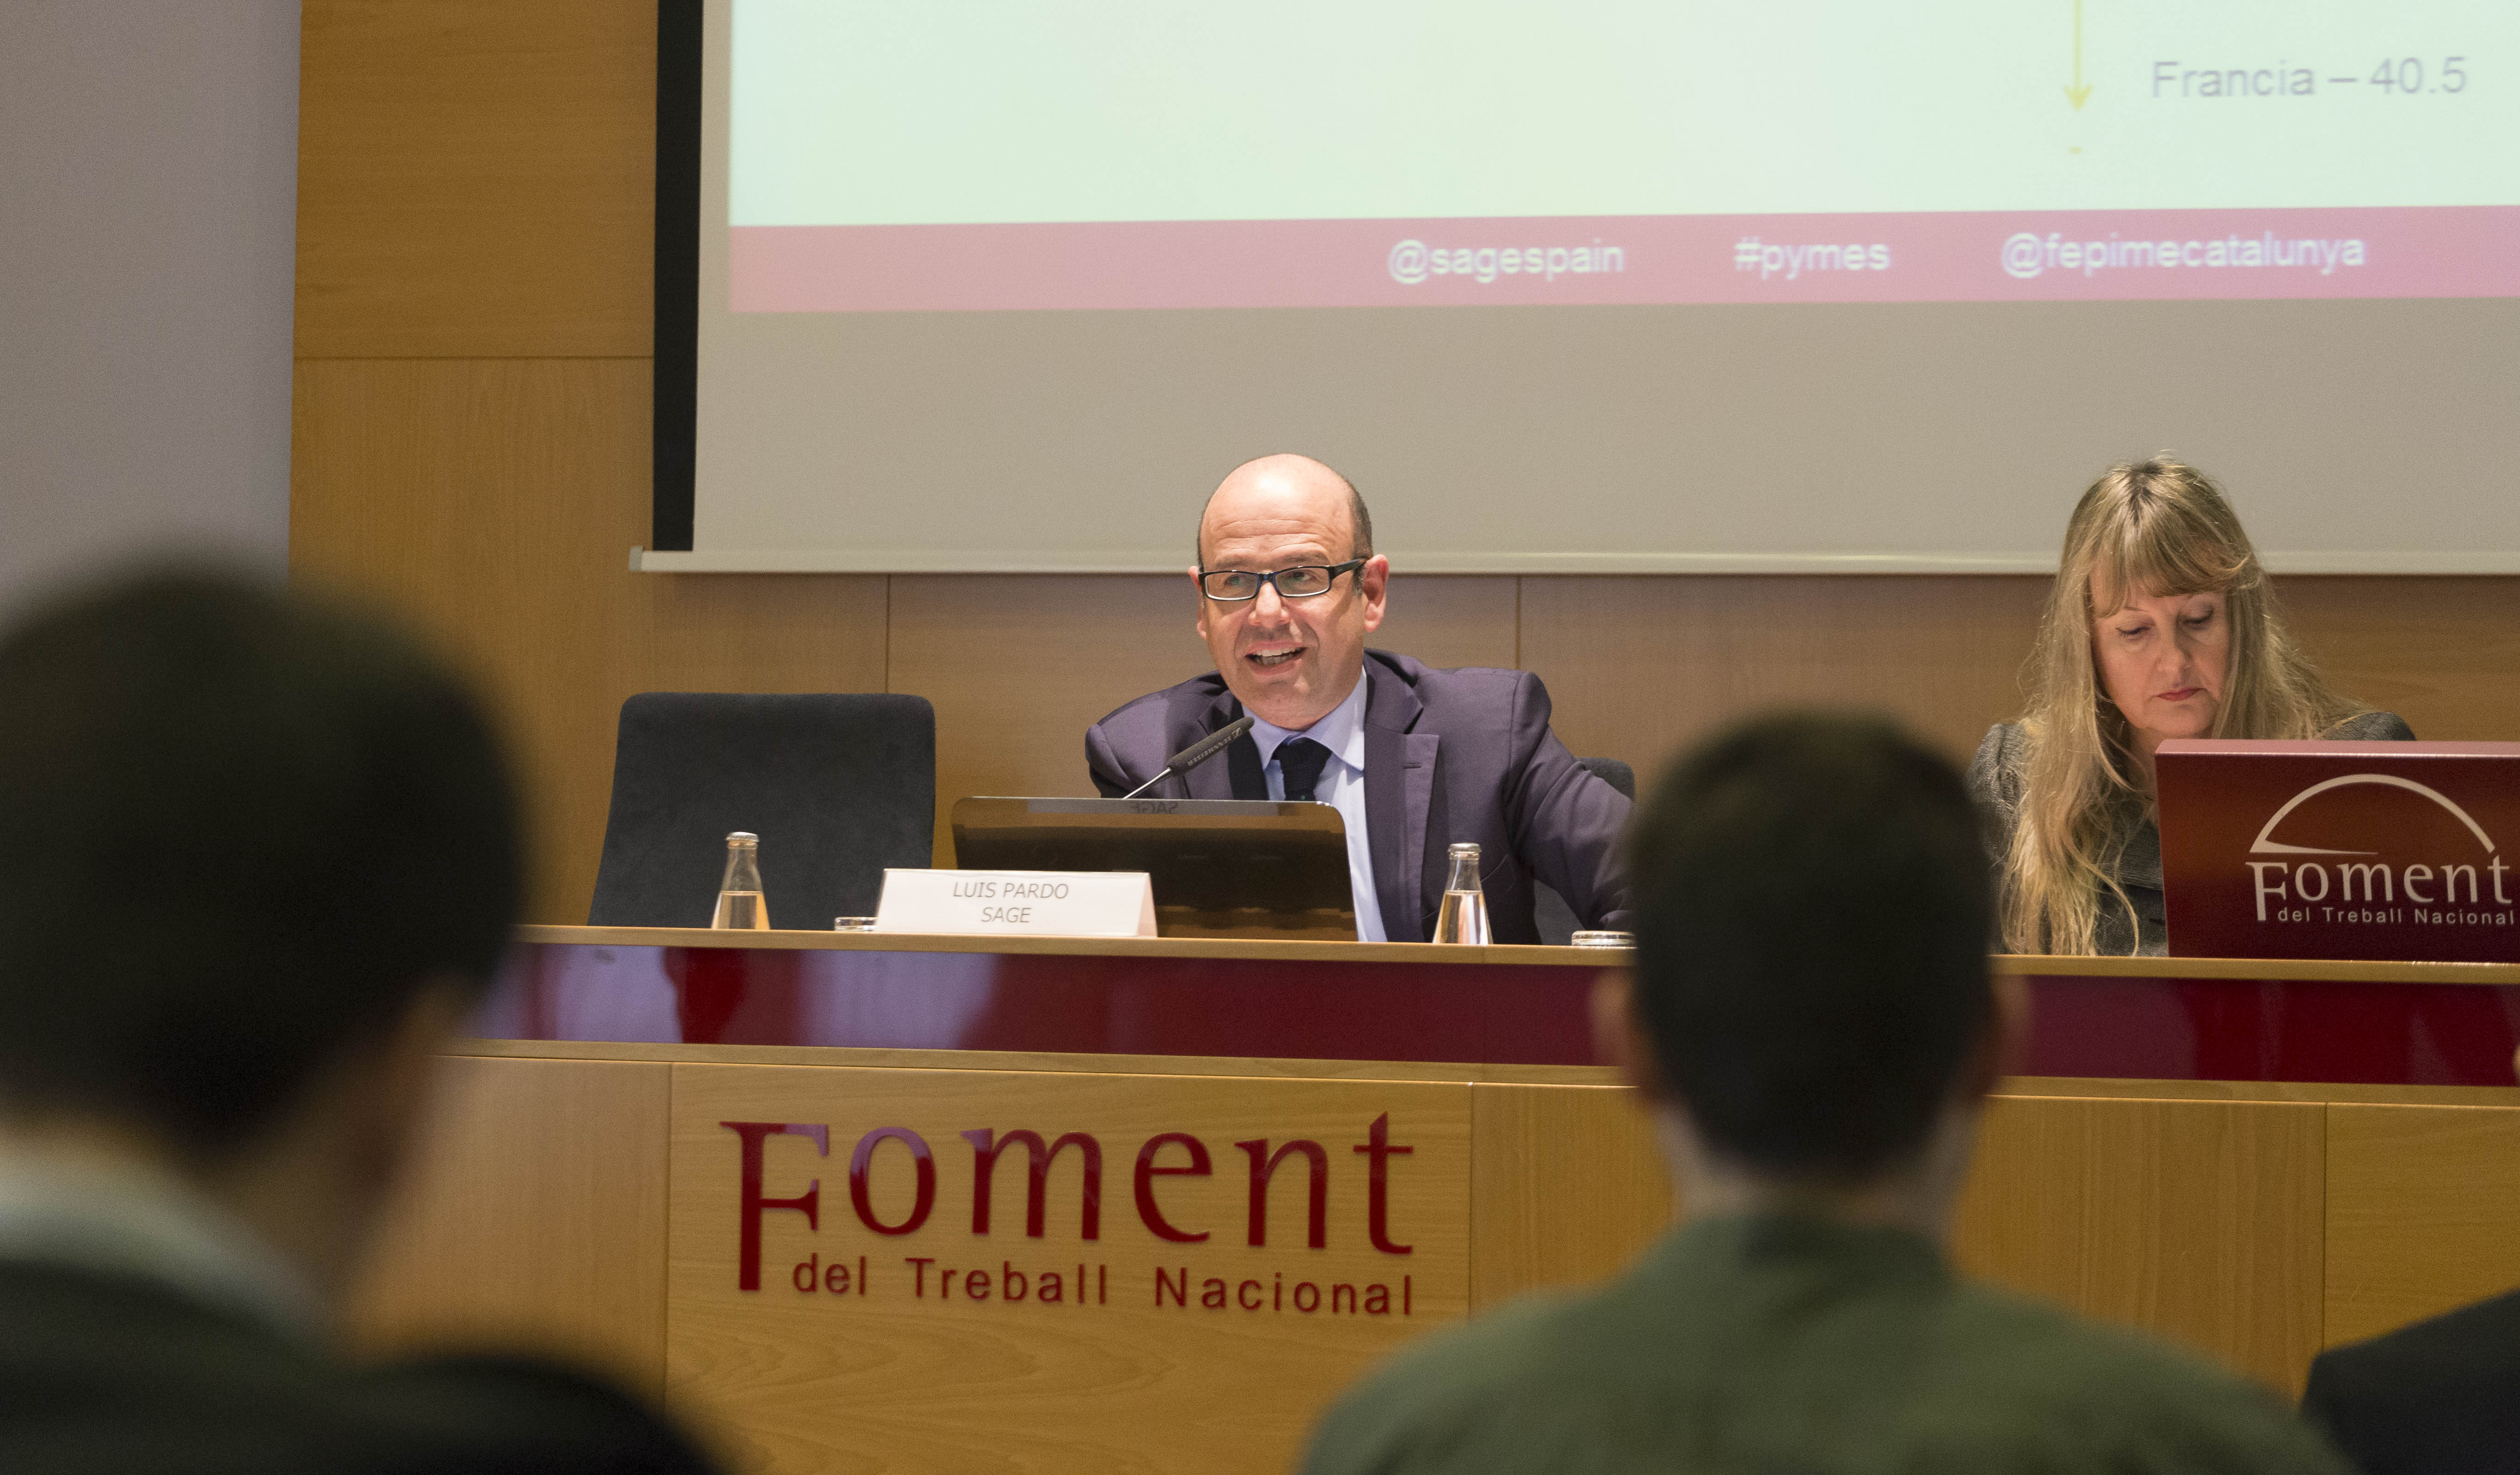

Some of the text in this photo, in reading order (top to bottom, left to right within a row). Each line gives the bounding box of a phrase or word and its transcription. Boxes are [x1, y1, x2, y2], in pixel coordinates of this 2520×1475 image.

[2153, 60, 2316, 98] Francia
[2369, 55, 2467, 95] 40.5
[1388, 231, 2365, 285] @sagespain #pymes @fepimecatalunya
[1187, 736, 1232, 766] SENNHEISER
[953, 881, 1069, 900] LUIS PARDO
[2245, 855, 2514, 921] Foment
[981, 906, 1032, 924] SAGE
[2278, 906, 2514, 925] del Treball Nacional
[719, 1111, 1414, 1291] Foment
[792, 1252, 1412, 1316] del Treball Nacional
